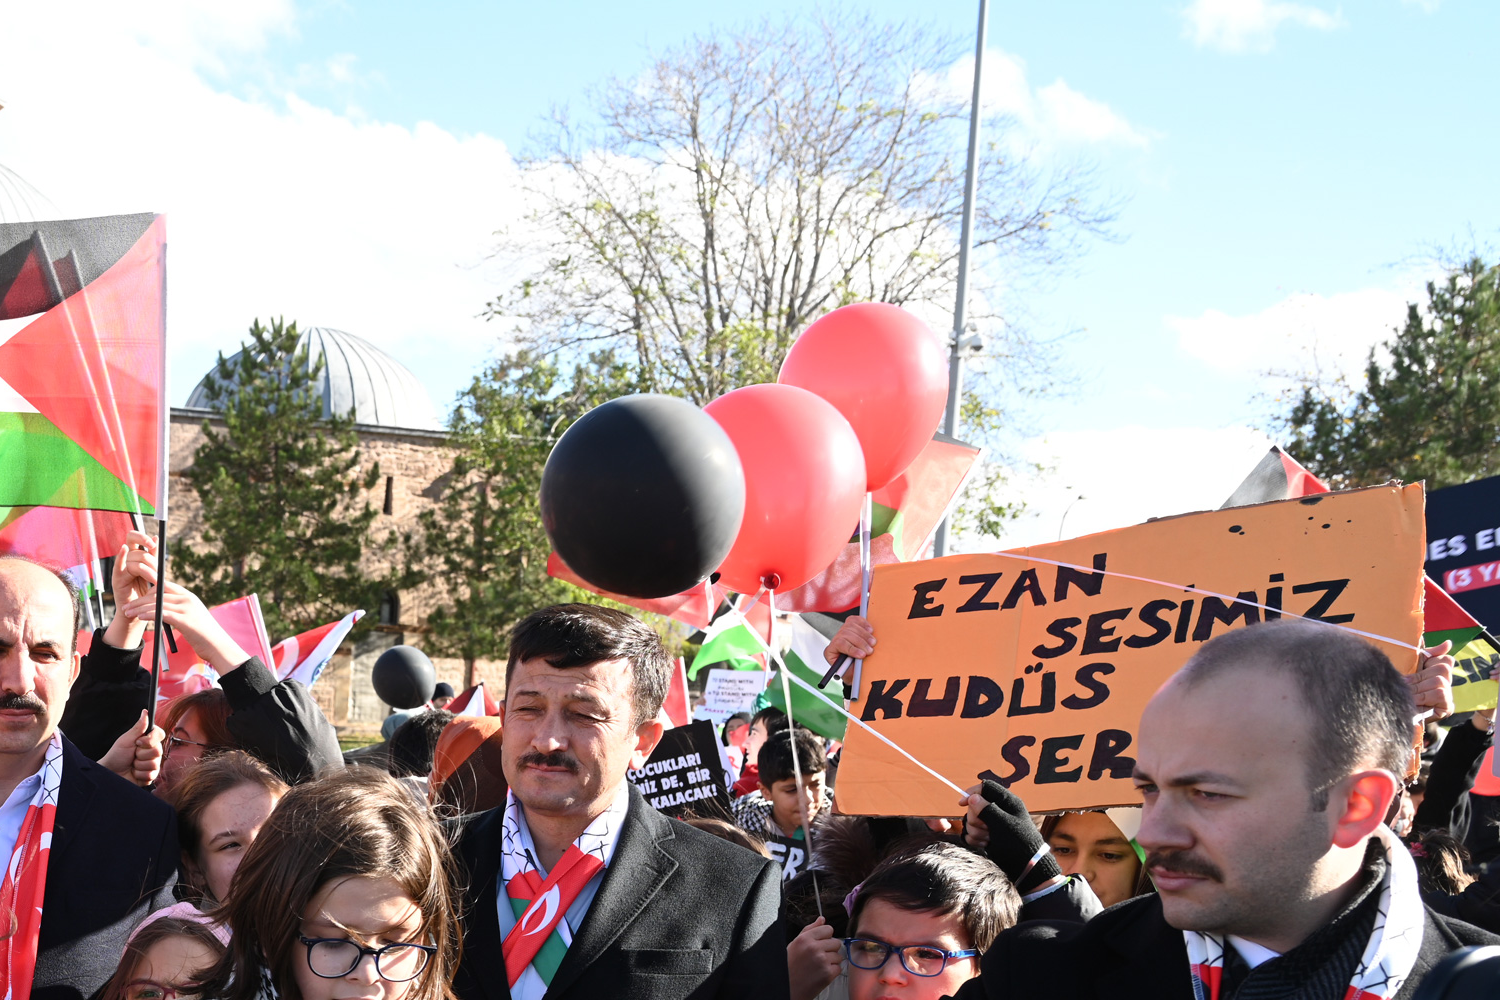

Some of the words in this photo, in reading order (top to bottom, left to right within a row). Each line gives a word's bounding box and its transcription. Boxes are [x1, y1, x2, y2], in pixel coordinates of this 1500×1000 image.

[1425, 535, 1467, 562] ES
[907, 552, 1108, 620] EZAN
[1446, 568, 1472, 593] (3
[1031, 572, 1356, 659] SESİMİZ
[859, 661, 1116, 722] KUDÜS
[627, 752, 702, 783] ÇOCUKLARI
[686, 767, 711, 785] BİR
[651, 784, 718, 810] KALACAK!
